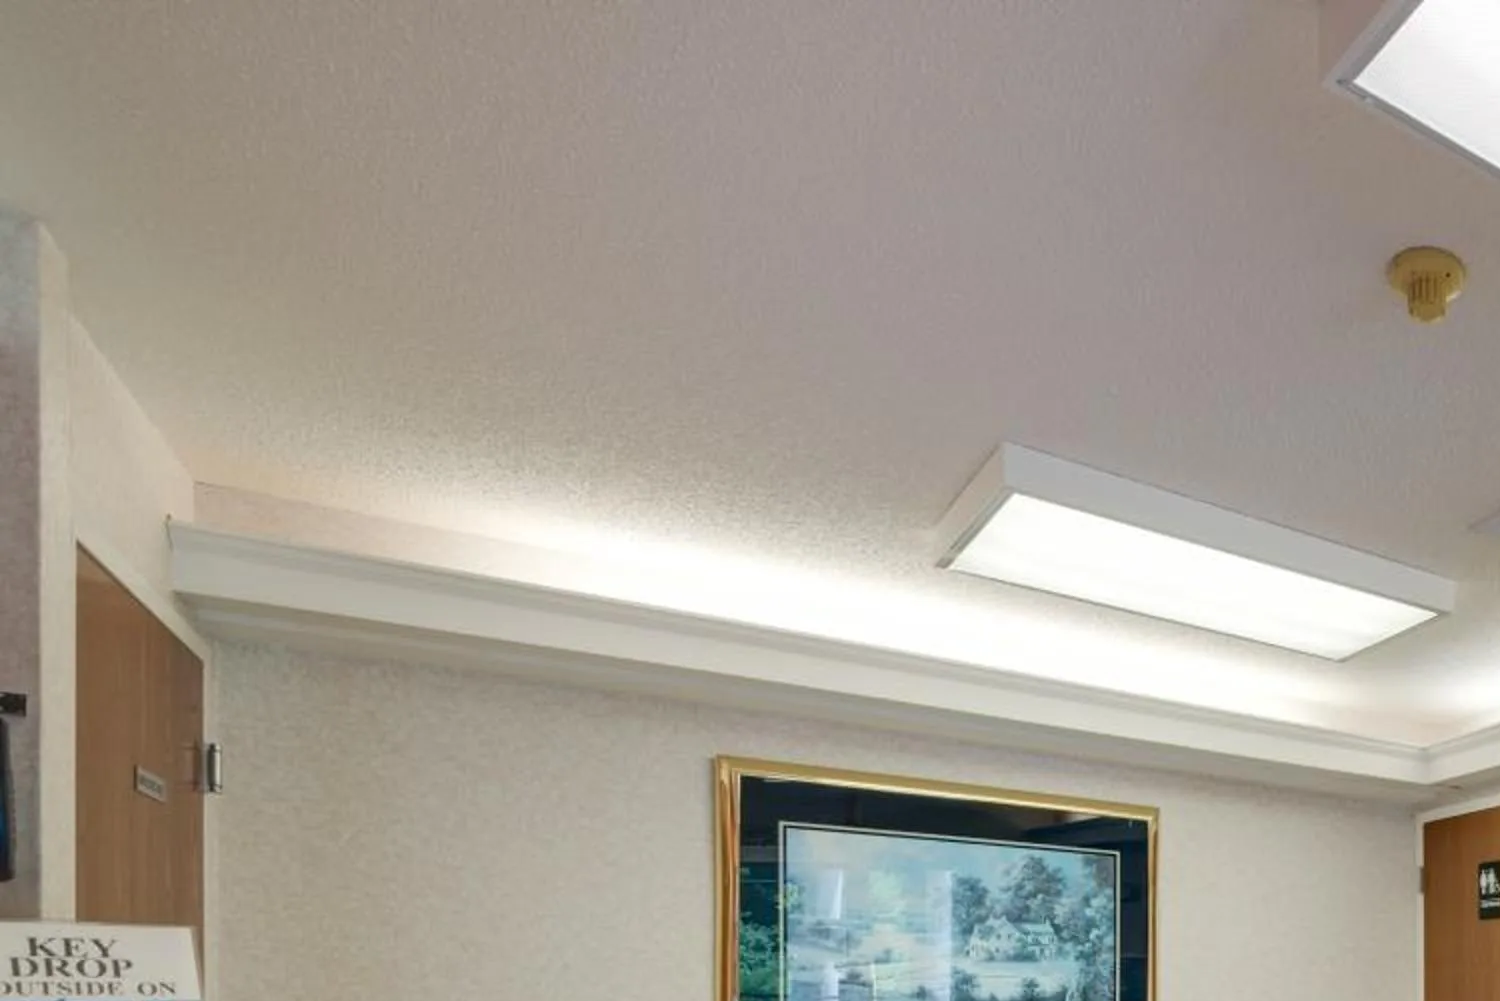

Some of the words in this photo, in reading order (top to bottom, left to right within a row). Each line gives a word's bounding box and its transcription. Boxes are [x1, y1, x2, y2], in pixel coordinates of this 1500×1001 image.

[27, 936, 117, 958] KEY
[10, 956, 133, 979] DROP
[0, 981, 125, 997] OUTSIDE
[137, 981, 177, 996] ON
